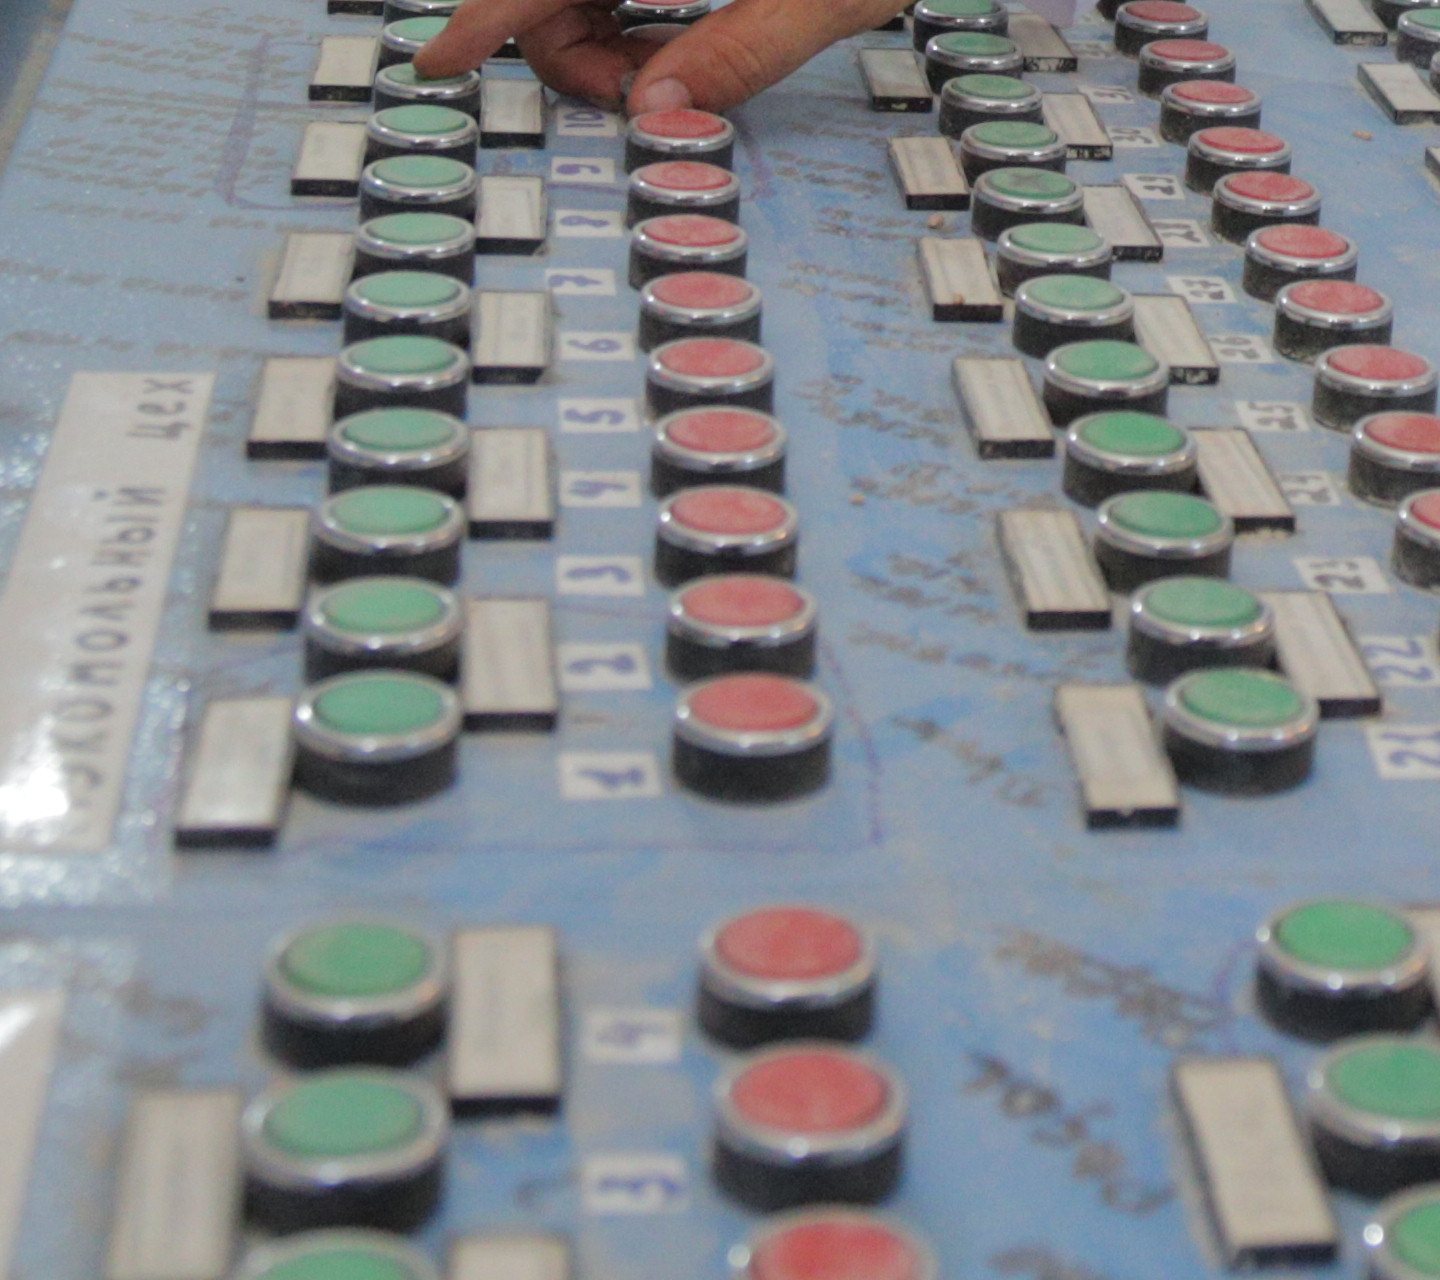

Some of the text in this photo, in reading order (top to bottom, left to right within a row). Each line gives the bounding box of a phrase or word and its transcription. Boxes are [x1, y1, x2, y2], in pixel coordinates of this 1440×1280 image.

[561, 109, 606, 129] 10
[1110, 126, 1154, 145] 30
[555, 162, 602, 176] 9
[1181, 277, 1226, 302] 27
[565, 337, 622, 354] 6
[1209, 334, 1260, 360] 26
[126, 376, 195, 440] цех
[563, 407, 626, 425] 5
[1248, 400, 1298, 431] 25
[567, 478, 629, 498] 4
[564, 564, 633, 584] 3
[1307, 557, 1367, 590] 23
[567, 653, 637, 676] 2
[1362, 638, 1434, 683] 22
[574, 764, 646, 792] 1
